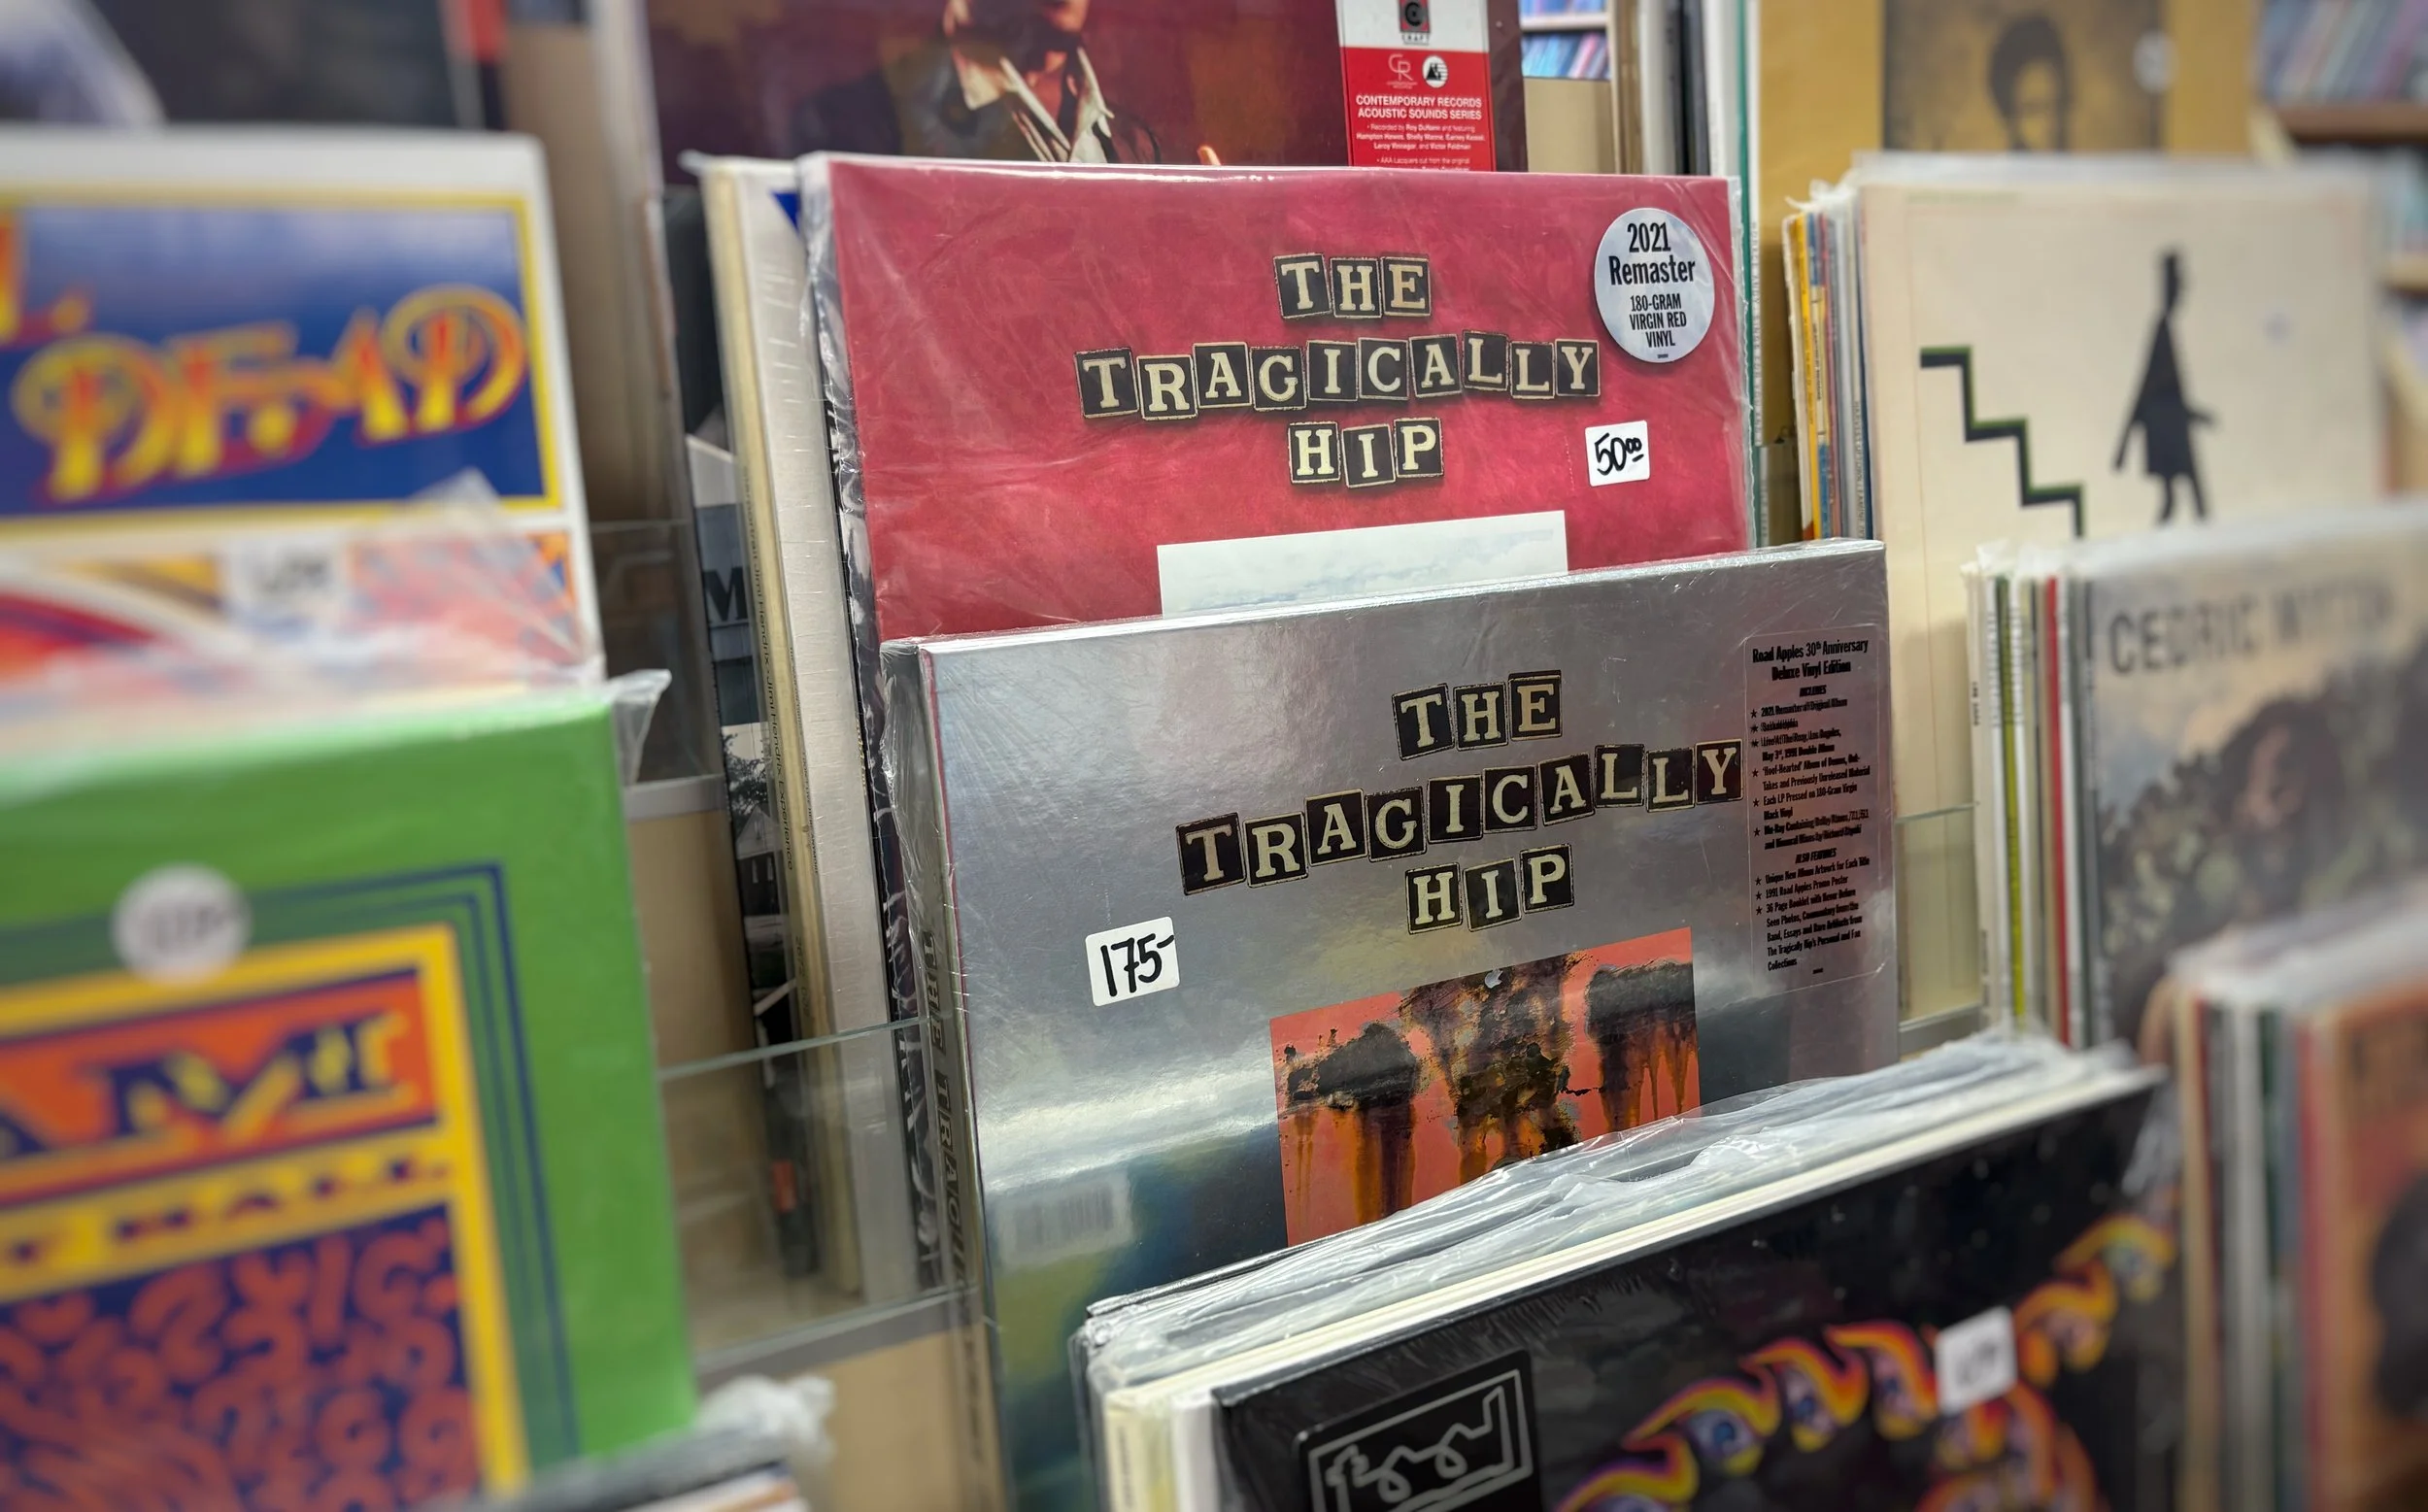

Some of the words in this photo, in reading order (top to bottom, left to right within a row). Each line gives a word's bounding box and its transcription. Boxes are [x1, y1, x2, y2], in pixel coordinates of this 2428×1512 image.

[1356, 95, 1435, 107] CONTEMPORARY
[1437, 97, 1482, 107] RECORDS
[1358, 109, 1406, 118] ACOUSTIC
[1409, 109, 1448, 118] SOUNDS
[1450, 111, 1482, 120] SERIES
[1627, 221, 1670, 252] 2021
[1608, 254, 1696, 286] Remaster
[1279, 258, 1429, 315] THE
[1630, 293, 1682, 312] 180-GRAM
[1630, 313, 1665, 330] VIRGIN
[1667, 311, 1687, 327] RED
[1645, 330, 1676, 348] VINYL
[1079, 333, 1598, 418] TRAGICALLY
[1294, 423, 1439, 480] HIP
[754, 563, 765, 598] Jimi
[758, 601, 770, 664] Hendrix
[1752, 648, 1773, 662] Road
[1776, 646, 1804, 662] Apples
[1822, 639, 1869, 655] Anniversary
[1771, 667, 1800, 681] Deluxe
[1803, 662, 1821, 678] Vinyl
[1824, 659, 1851, 674] Edition
[766, 676, 775, 710] Jimi
[1398, 680, 1557, 749] THE
[771, 713, 782, 776] Hendrix
[1762, 781, 1779, 790] Takes
[1779, 778, 1790, 789] and
[1791, 774, 1818, 787] Previously
[1818, 769, 1847, 783] Unreleased
[1849, 766, 1871, 778] Material
[1764, 795, 1777, 806] Each
[1777, 793, 1785, 804] LP
[1786, 790, 1808, 802] Pressed
[1841, 783, 1857, 794] Virgin
[778, 780, 792, 871] Experience
[1183, 744, 1739, 885] TRAGICALLY
[1764, 809, 1779, 820] Black
[1779, 807, 1793, 819] Vinyl
[1785, 820, 1814, 831] Containing
[1795, 854, 1810, 864] ALSO
[1810, 848, 1838, 860] FEATURES
[1766, 873, 1784, 884] Unique
[1785, 870, 1797, 880] New
[1797, 868, 1814, 878] Album
[1814, 863, 1836, 875] Artwork
[1845, 858, 1858, 869] Each
[1412, 852, 1568, 926] HIP
[1766, 889, 1779, 899] 1991
[1779, 885, 1793, 896] Road
[1795, 882, 1812, 893] Apples
[1812, 879, 1830, 890] Promo
[1831, 875, 1849, 886] Poster
[1766, 903, 1773, 914] 36
[1774, 902, 1787, 913] Page
[1789, 897, 1809, 909] Booklet
[1810, 894, 1822, 905] with
[1822, 891, 1838, 901] Never
[1838, 889, 1856, 899] Before
[1767, 918, 1780, 928] Seen
[1781, 914, 1801, 924] Photos,
[1803, 908, 1836, 921] Commentary
[1767, 931, 1783, 942] Band,
[1783, 927, 1802, 940] Essays
[1803, 924, 1812, 935] and
[1813, 923, 1826, 932] Rare
[1768, 947, 1777, 957] The
[1777, 941, 1803, 956] Tragically
[1804, 939, 1816, 950] Hip's
[1817, 933, 1839, 946] Personal
[1840, 930, 1851, 941] and
[1851, 928, 1861, 938] Fan
[1768, 958, 1797, 971] Collections
[924, 931, 946, 1056] THE
